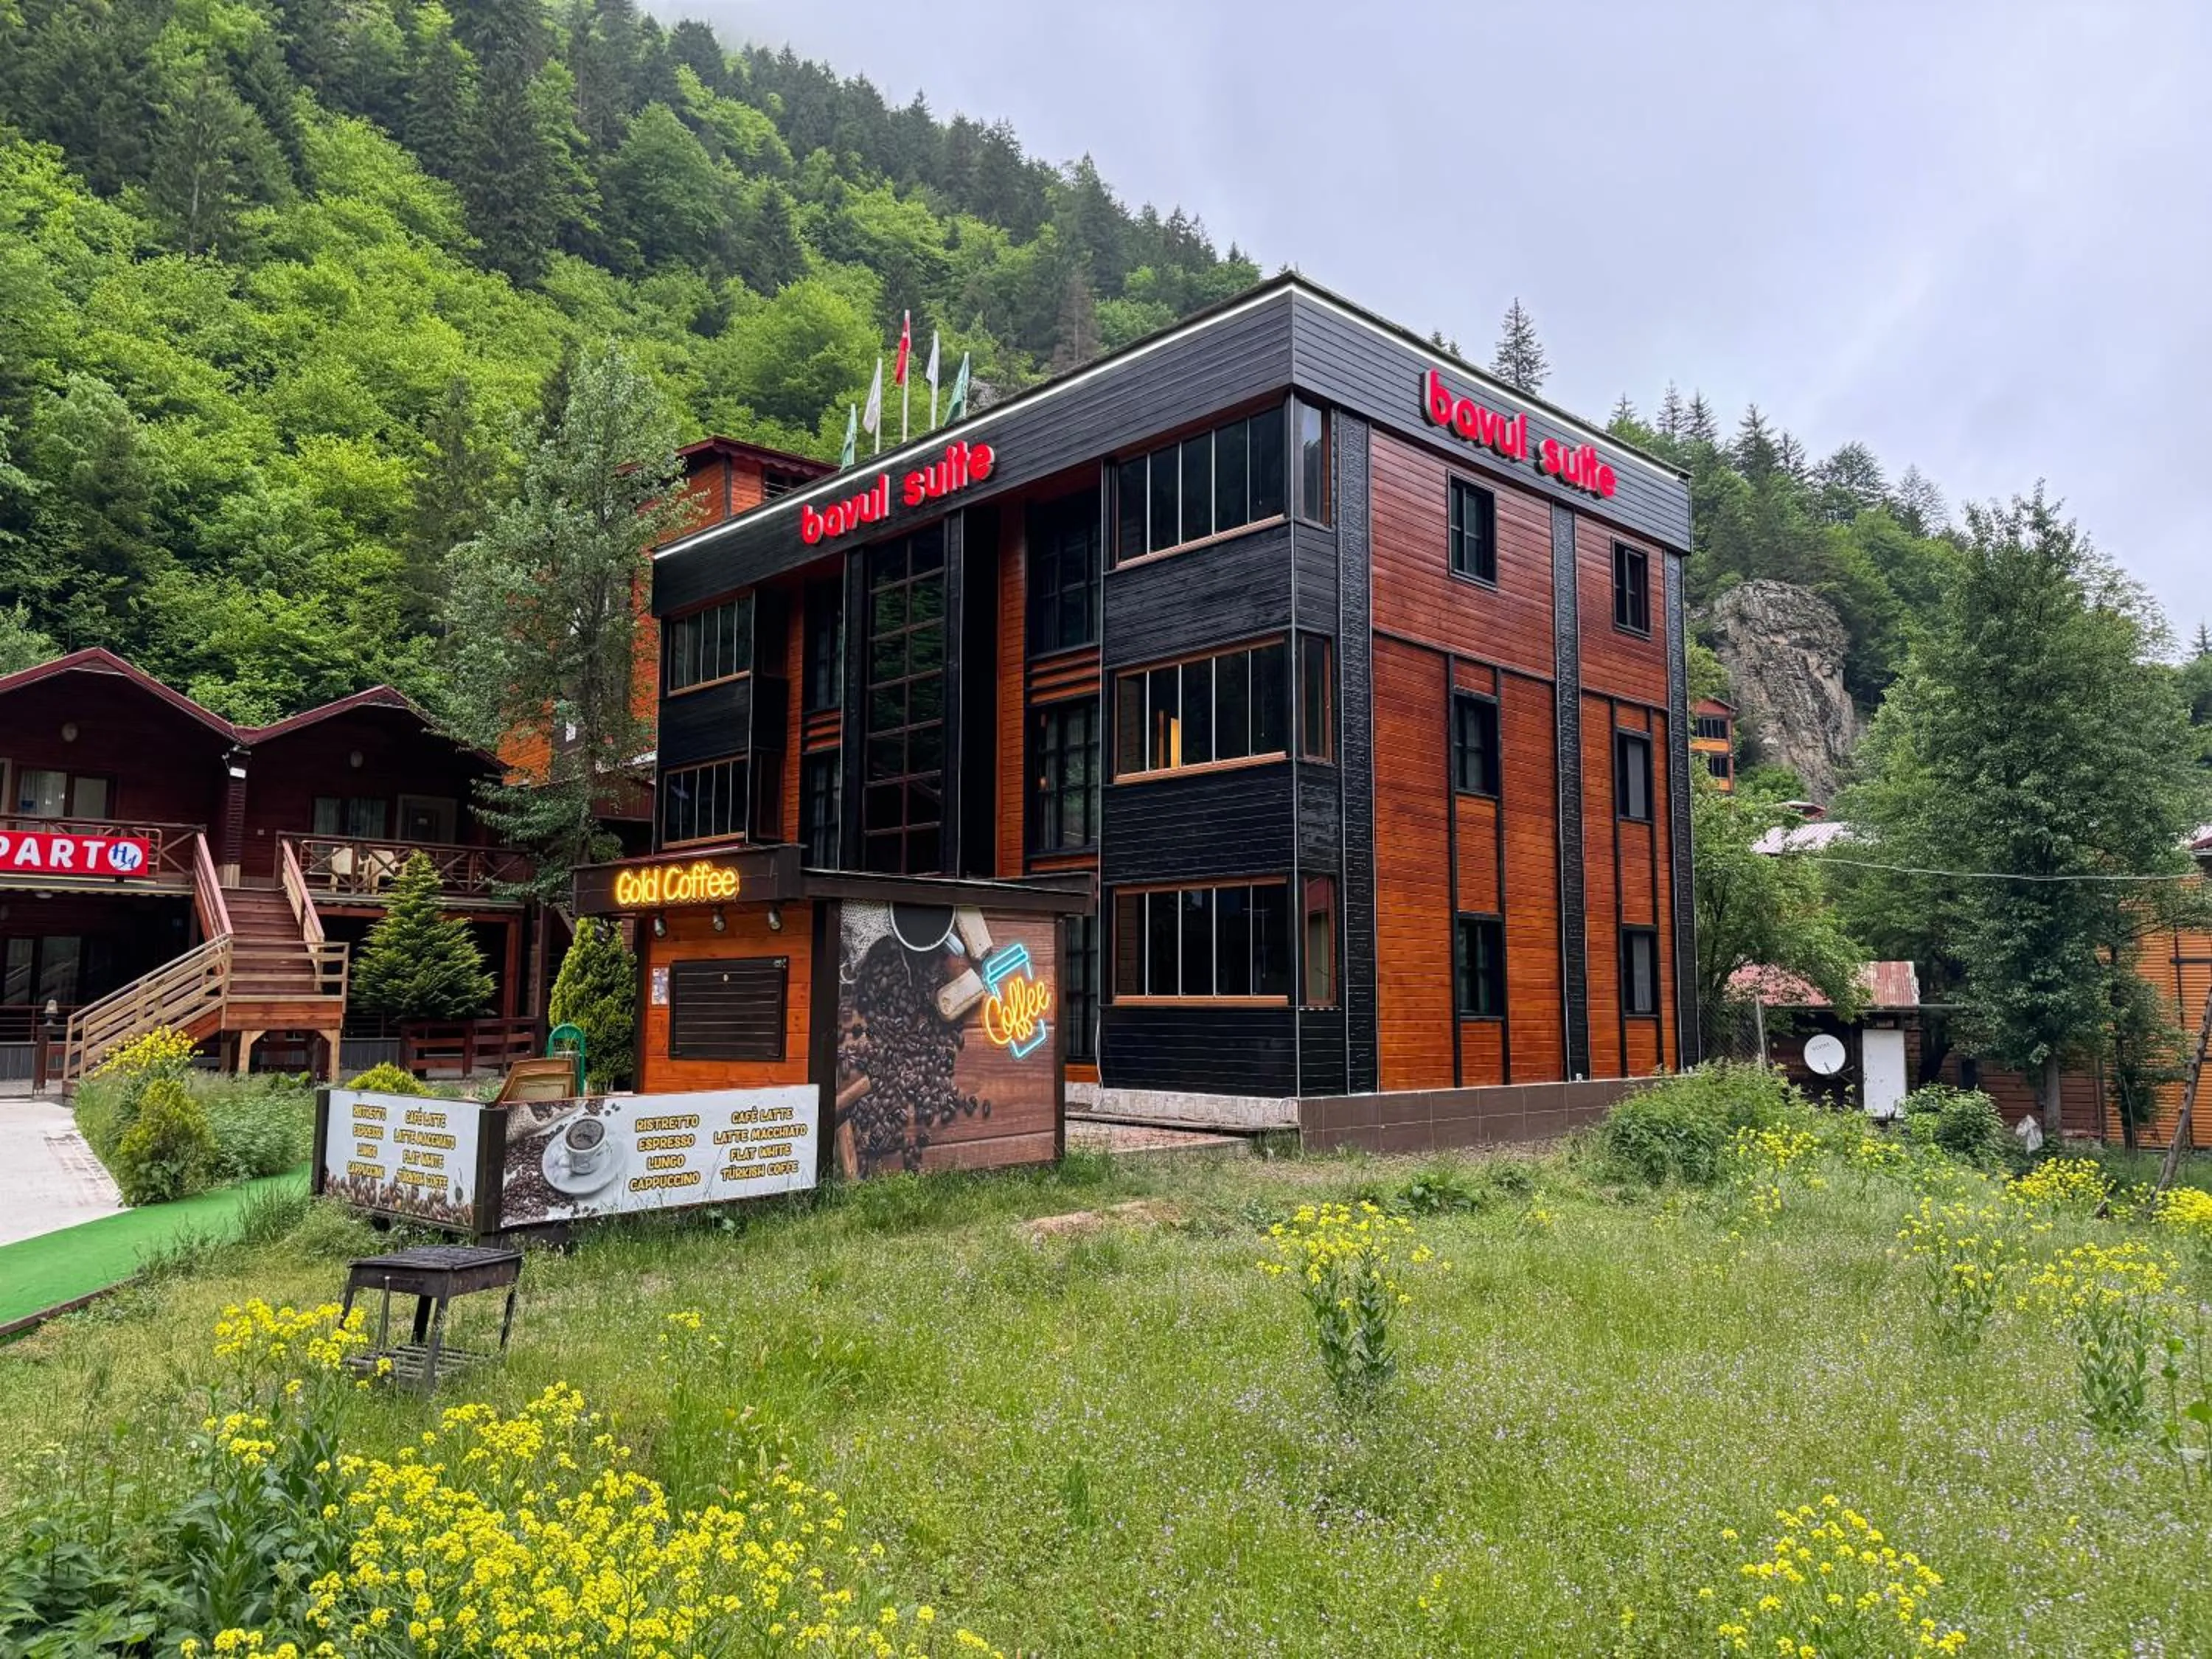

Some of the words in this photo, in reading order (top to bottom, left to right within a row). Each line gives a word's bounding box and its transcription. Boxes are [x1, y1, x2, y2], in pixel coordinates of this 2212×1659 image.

[1425, 366, 1528, 461] bavul
[1538, 437, 1617, 499] suite
[801, 473, 889, 544] bavul
[903, 440, 995, 506] suite
[616, 866, 661, 907] Gold
[663, 860, 739, 902] Coffee
[984, 975, 1051, 1046] Coffee
[636, 1114, 700, 1133] RISTRETTO
[759, 1107, 794, 1122] LATTE
[637, 1134, 696, 1152] ESPRESSO
[714, 1129, 749, 1145] LATTE
[751, 1123, 808, 1141] MACCHIATO
[647, 1154, 686, 1170] LUNGO
[730, 1147, 757, 1162] FLAT
[758, 1143, 793, 1159] WHITE
[767, 1160, 799, 1176] COFFE
[629, 1171, 700, 1192] CAPPUCCINO
